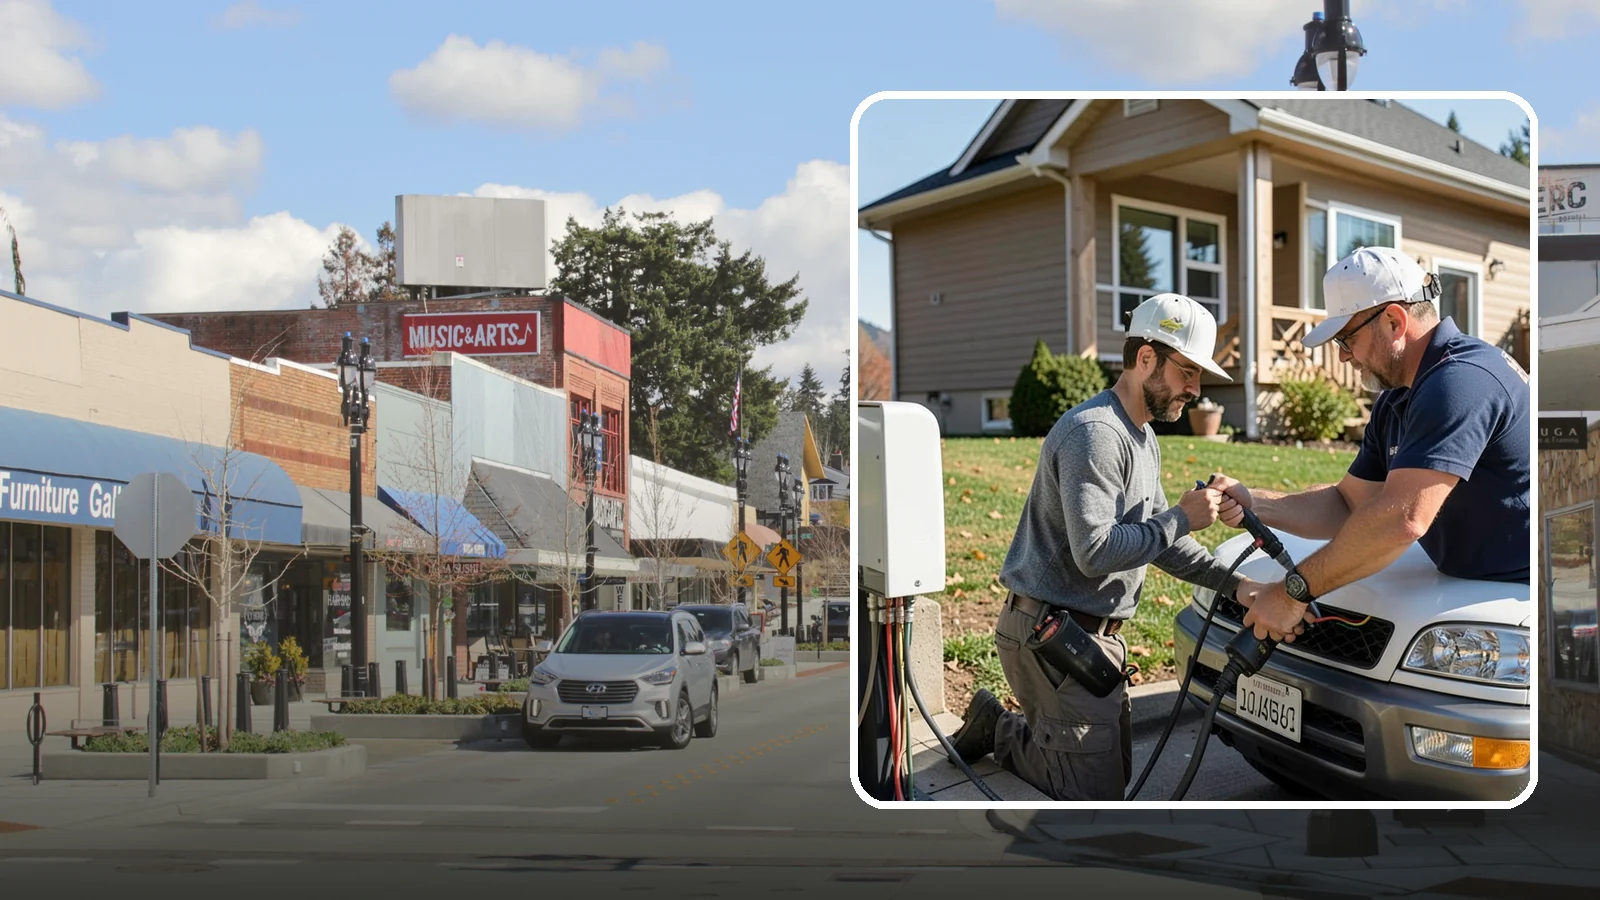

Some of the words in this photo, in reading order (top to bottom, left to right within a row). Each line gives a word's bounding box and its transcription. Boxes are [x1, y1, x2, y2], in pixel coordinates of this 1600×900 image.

[408, 322, 520, 349] MUSIC&ARTS
[0, 471, 79, 515] Furniture
[89, 482, 122, 519] Gal
[453, 563, 479, 575] SUSHI
